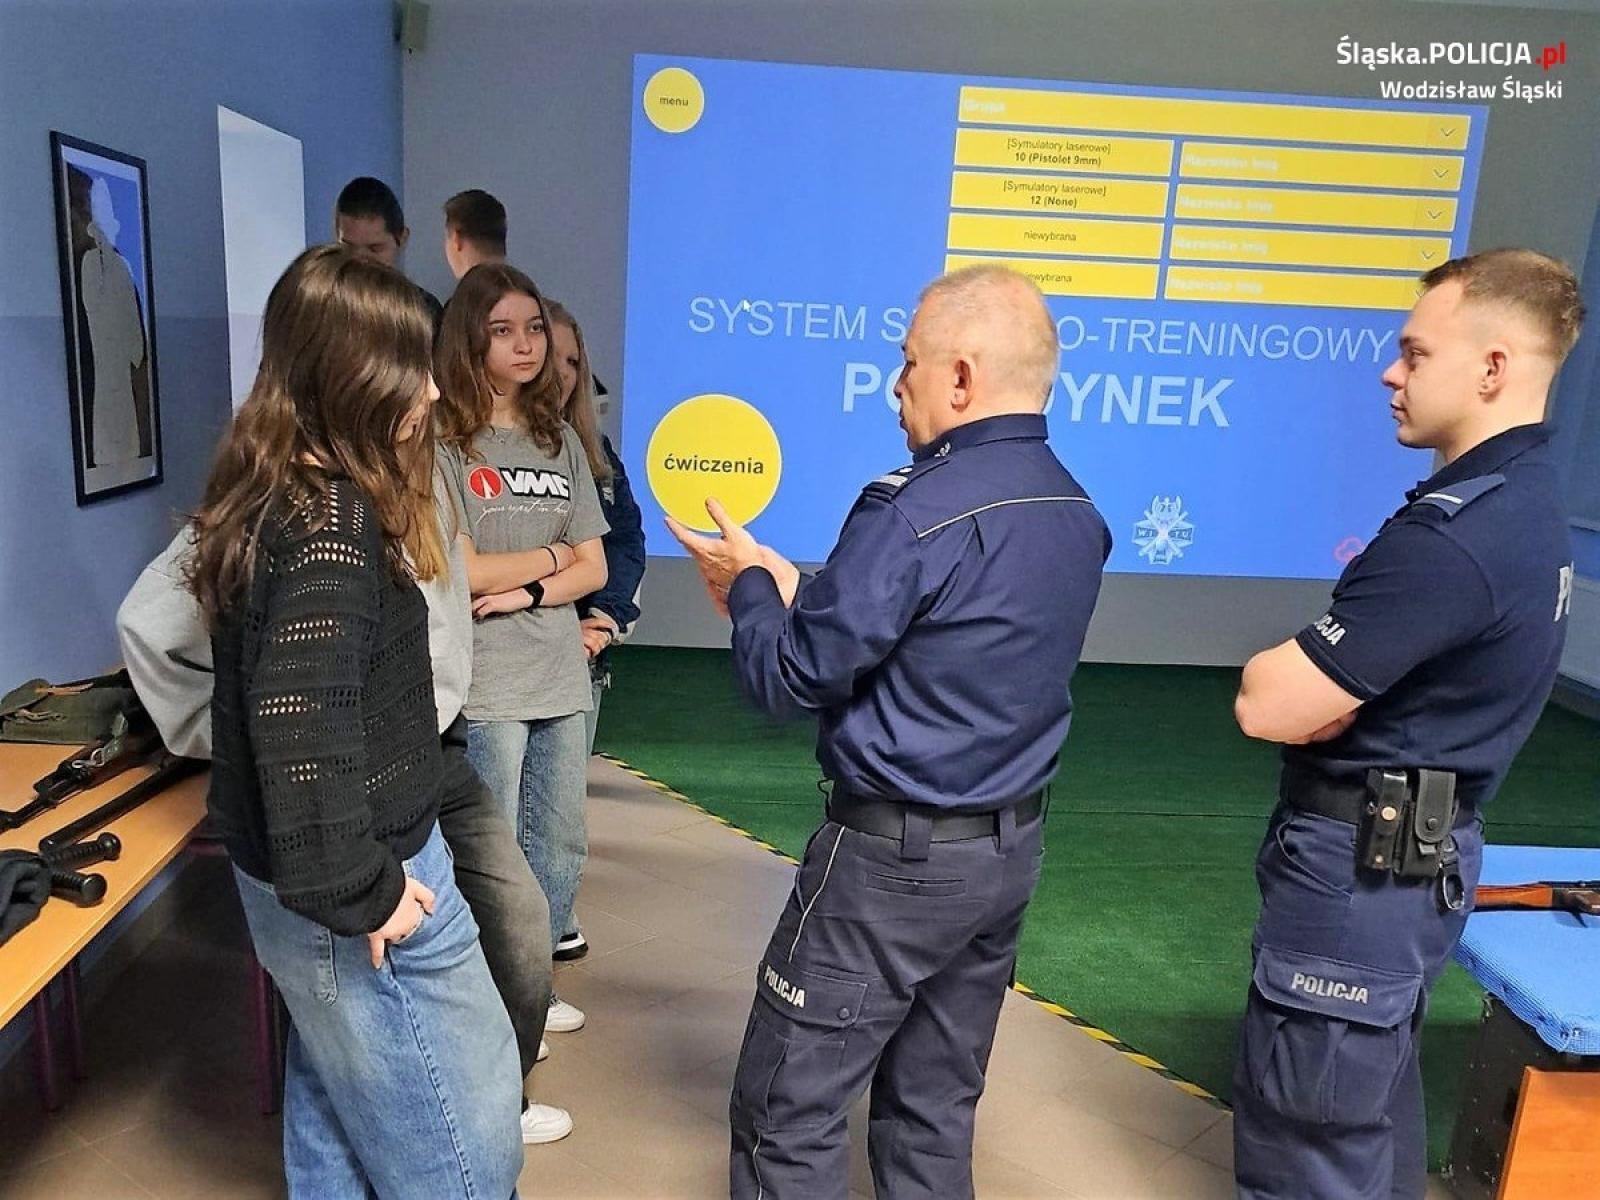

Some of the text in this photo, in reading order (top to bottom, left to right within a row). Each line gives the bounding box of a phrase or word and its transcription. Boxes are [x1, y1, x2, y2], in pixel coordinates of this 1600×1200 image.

[659, 96, 690, 107] menu
[1015, 152, 1102, 169] 10 (Pistolet 9mm)
[1030, 195, 1078, 209] 12 (None)
[1023, 229, 1077, 242] niewybrana
[1026, 272, 1073, 283] ewybrana
[688, 296, 866, 341] SYSTEM
[842, 362, 1235, 428] PYNEK
[664, 453, 764, 475] ćwiczenia
[764, 965, 806, 1009] POLICJA
[1291, 972, 1369, 1004] POLICJA
